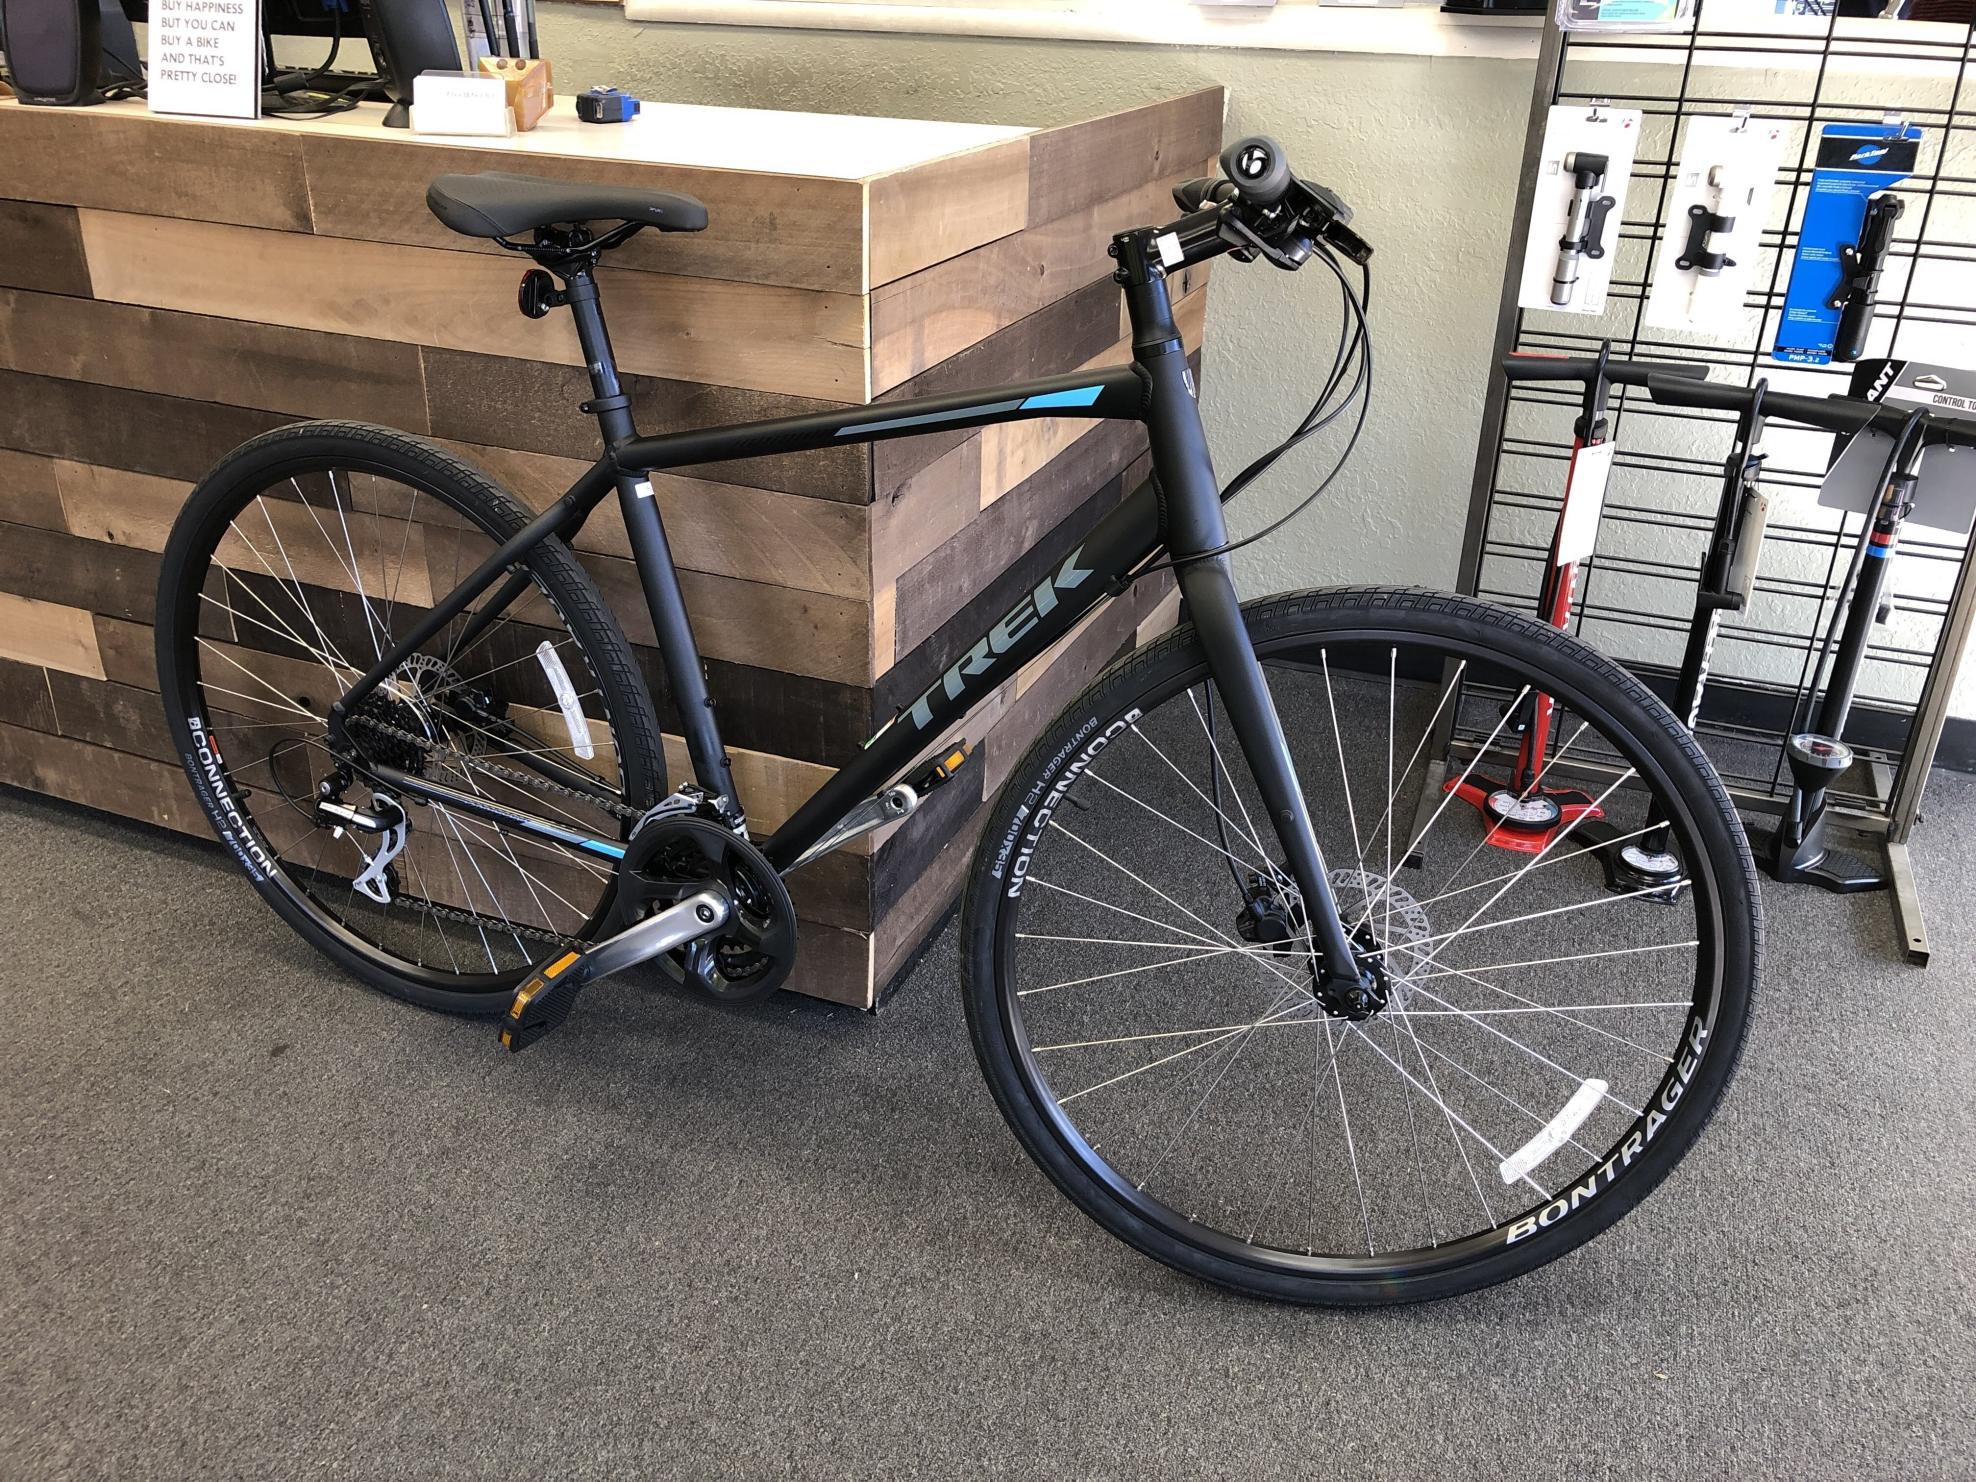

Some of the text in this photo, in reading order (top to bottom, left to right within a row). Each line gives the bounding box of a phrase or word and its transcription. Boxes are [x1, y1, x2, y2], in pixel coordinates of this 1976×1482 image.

[161, 0, 243, 14] BUY HAPPINESS
[161, 17, 234, 31] BUT YOU CAN
[161, 34, 219, 48] BUY A BIKE
[161, 52, 224, 66] AND THAT'S
[160, 69, 236, 84] PRETTY CLOSE!
[1932, 394, 1966, 409] CONTROL
[897, 542, 1095, 731] TREK
[1042, 716, 1099, 779] BONTRAGER
[184, 752, 214, 809] BONTRAGER
[211, 809, 228, 830] H2
[1024, 780, 1046, 806] H2
[192, 730, 278, 879] CONNECTION
[1007, 720, 1128, 898] CONNECTION
[1506, 1015, 1708, 1245] BONTRAGER
